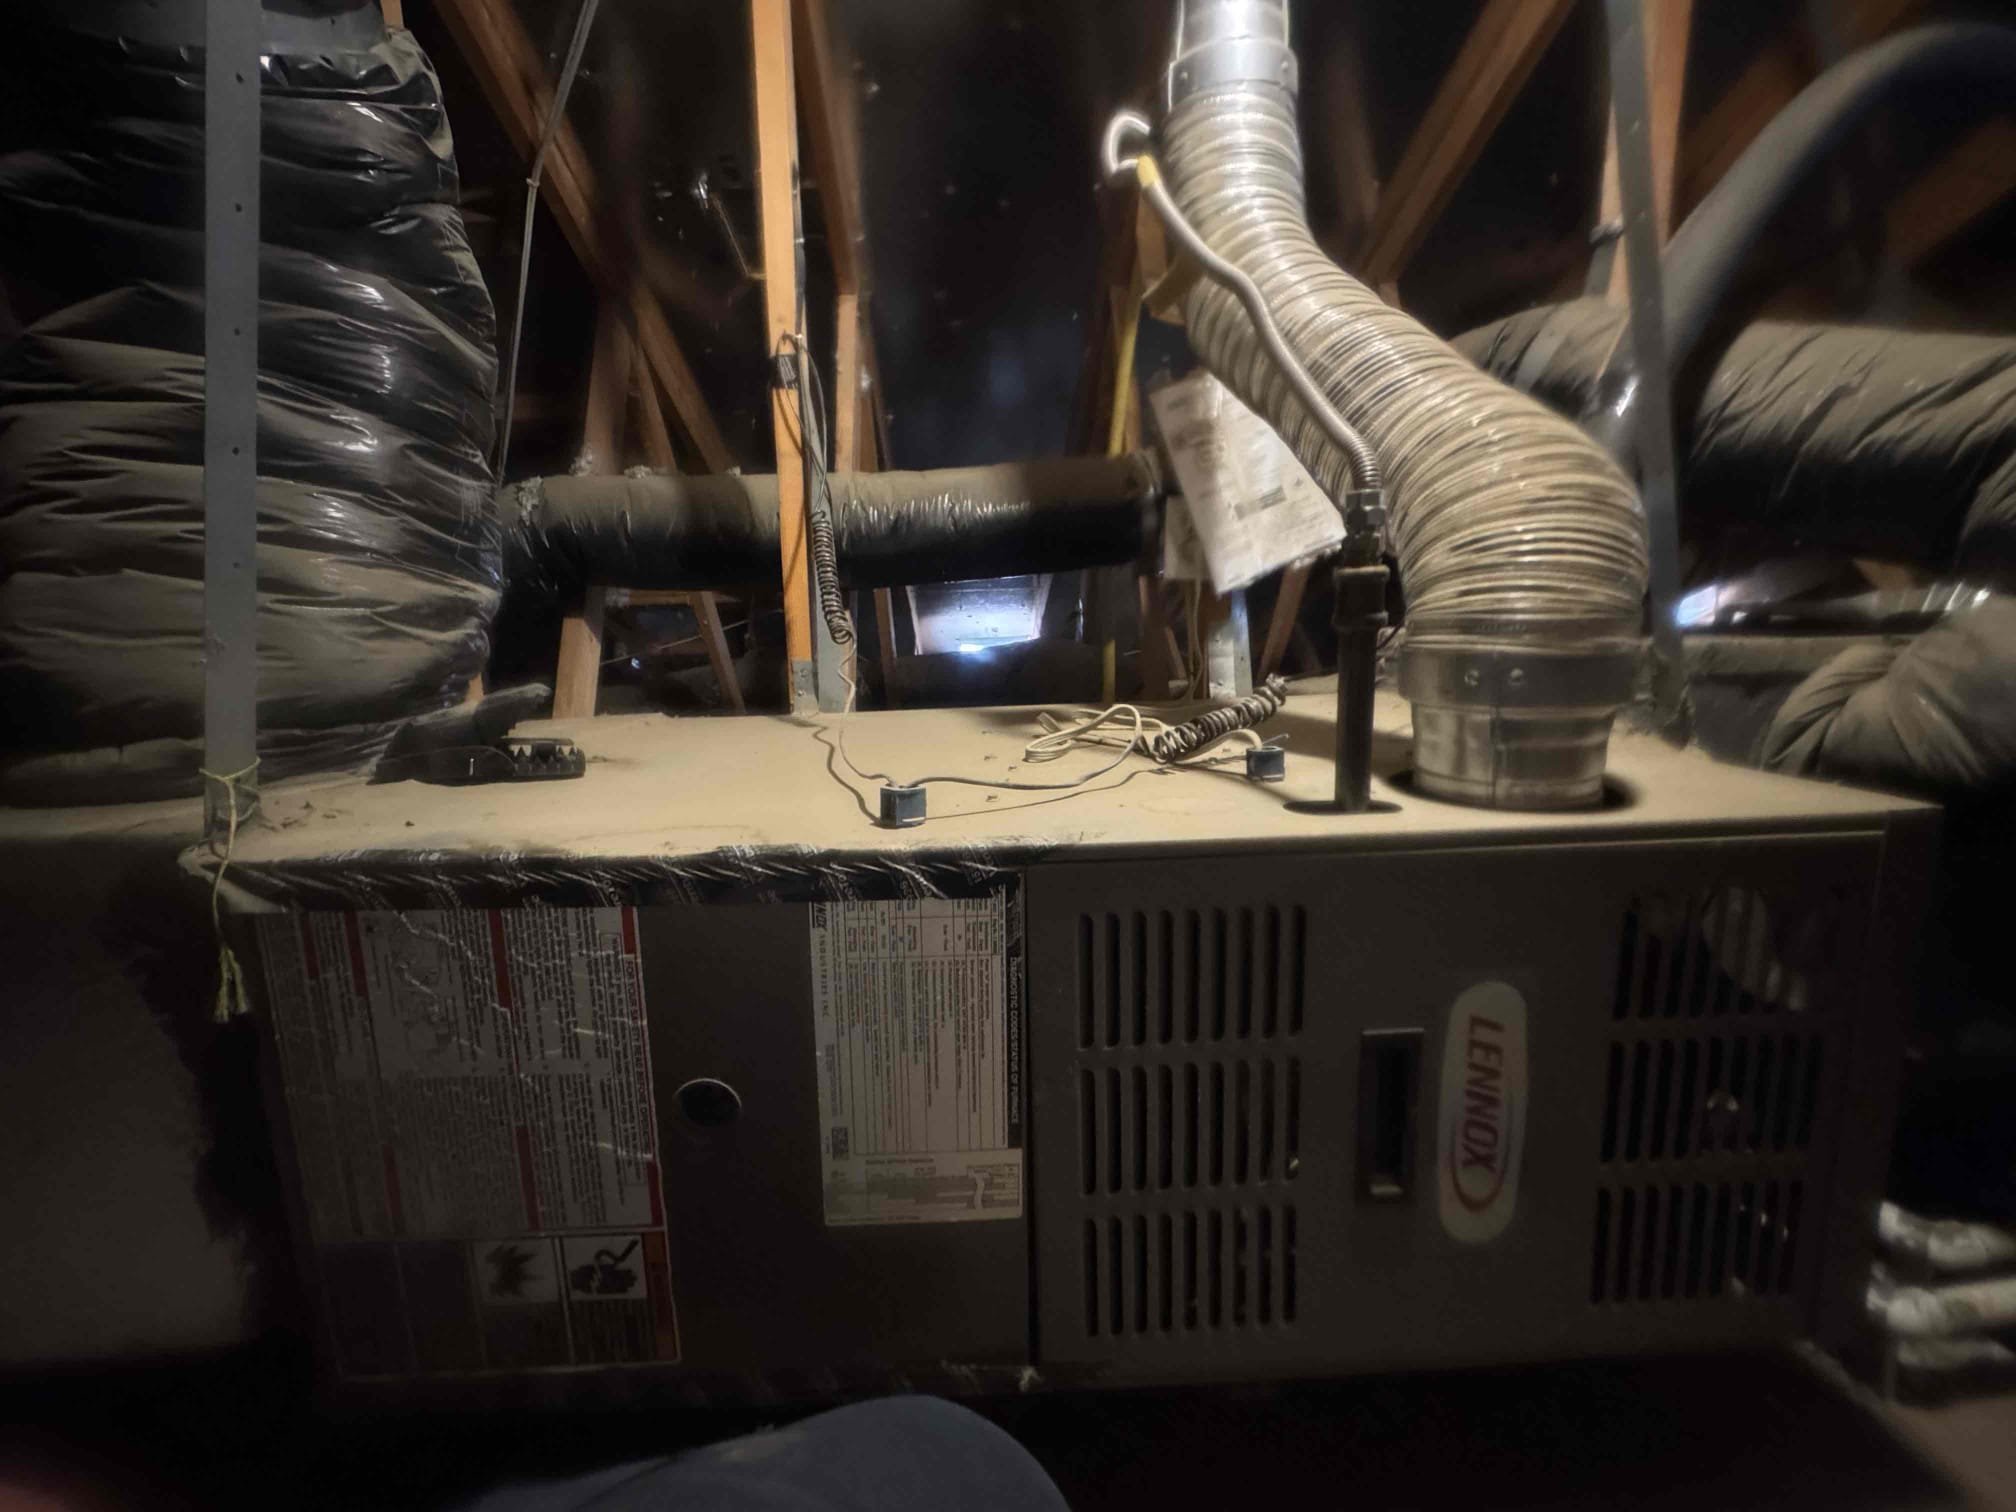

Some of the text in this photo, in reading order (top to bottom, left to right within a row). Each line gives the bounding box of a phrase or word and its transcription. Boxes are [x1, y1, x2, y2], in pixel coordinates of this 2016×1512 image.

[625, 960, 636, 981] FOR
[1009, 956, 1019, 1009] DIAGNOSTIC
[627, 982, 638, 1007] YOUR
[1010, 1085, 1019, 1124] FURNACE
[1461, 1014, 1505, 1173] LENNOX
